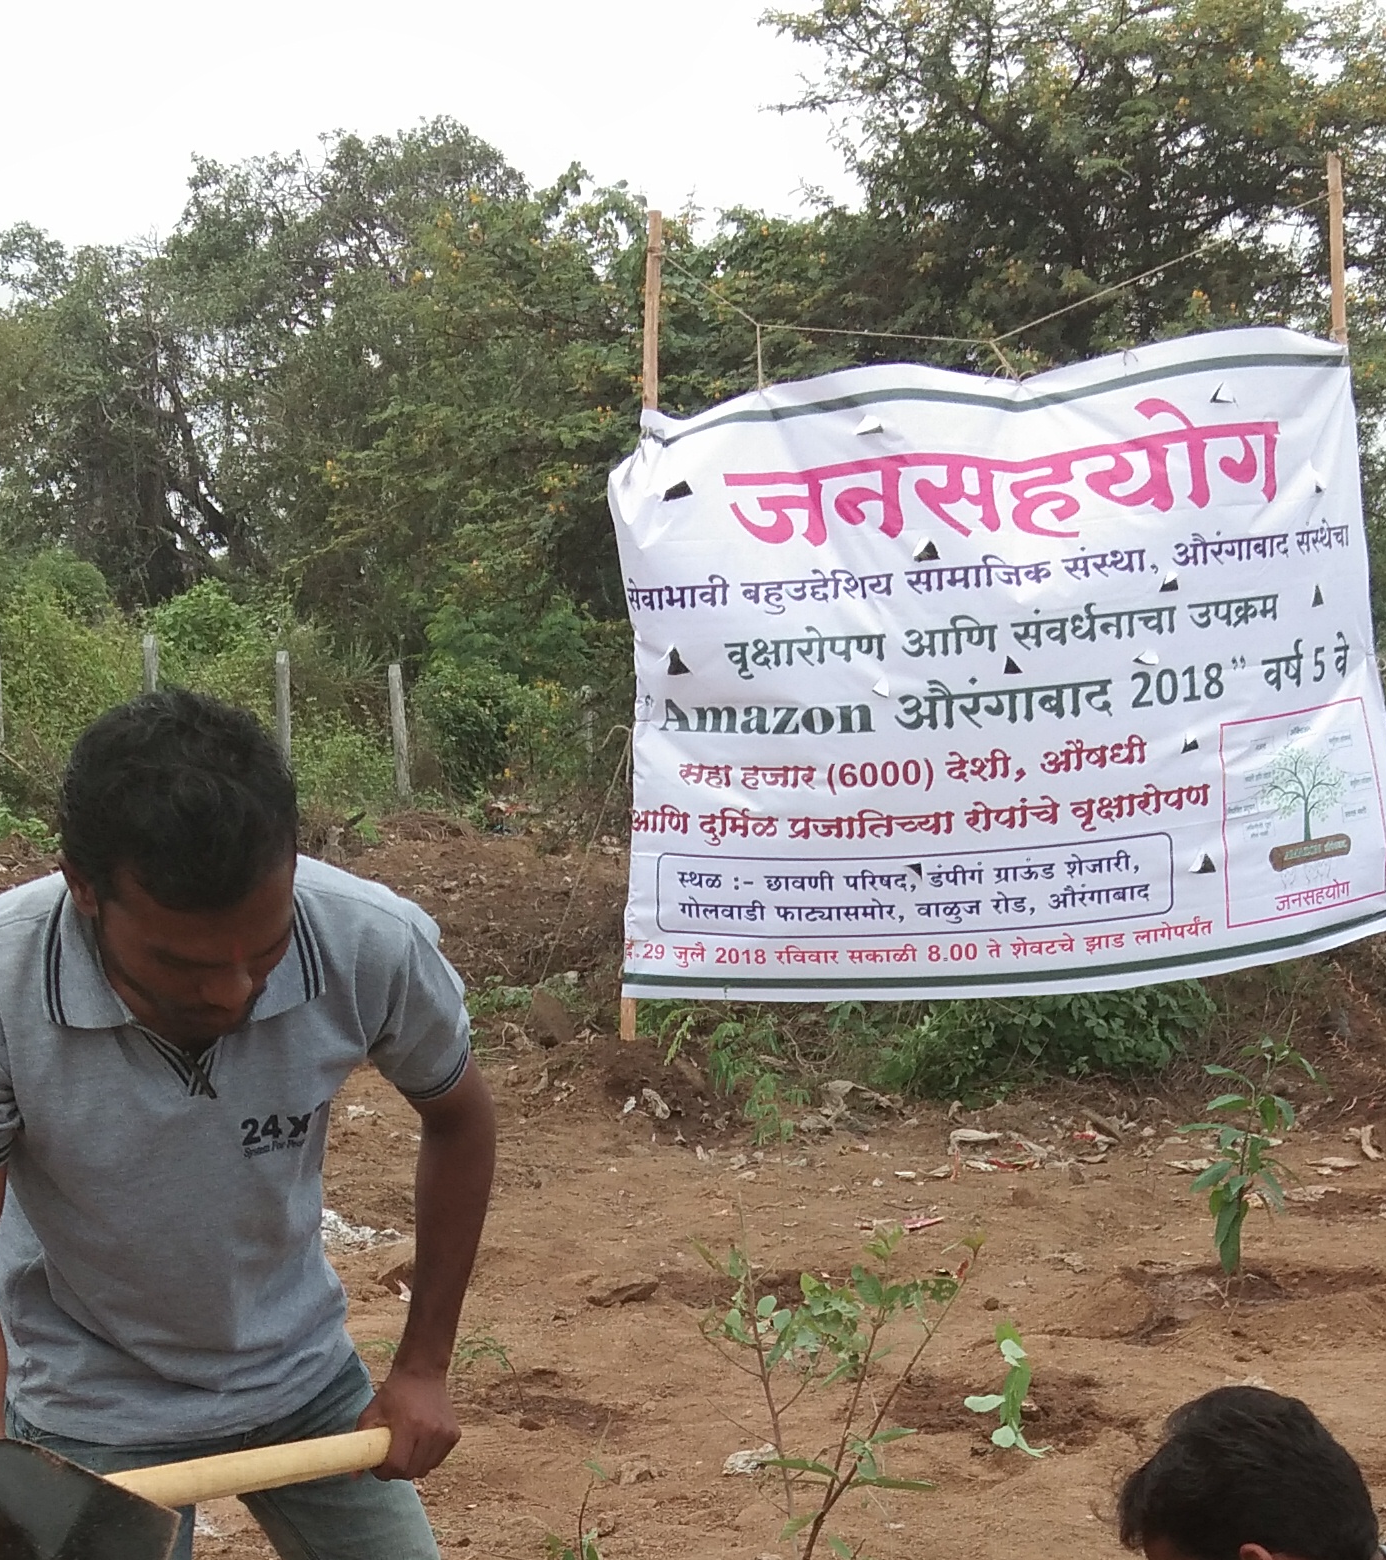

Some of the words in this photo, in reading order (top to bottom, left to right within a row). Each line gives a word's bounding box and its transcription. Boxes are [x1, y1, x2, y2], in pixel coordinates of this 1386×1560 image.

[724, 398, 1280, 547] जनसहयोग
[627, 575, 730, 612] सेवाभावी
[741, 569, 894, 615] बहुउद्देशिय
[905, 555, 1052, 594] सामाजिक
[1173, 531, 1291, 567] औरंगाबाद
[1295, 518, 1350, 554] संस्थेचा
[725, 626, 886, 680] वृक्षारोपण
[902, 614, 997, 658] आणि
[1011, 603, 1177, 652] संवर्धनाचा
[1188, 593, 1279, 629] उपक्रम
[895, 677, 1113, 730] औरंगाबाद
[1261, 638, 1304, 692] वर्ष
[1313, 646, 1325, 683] 5
[1334, 631, 1351, 678] वे
[678, 762, 733, 788] सहा
[741, 765, 816, 790] हजार
[826, 757, 934, 796] (6000)
[1040, 734, 1147, 775] औषधी
[631, 804, 690, 836] आणि
[699, 807, 779, 847] दुर्मिळ
[787, 808, 955, 840] प्रजातिच्या
[965, 795, 1060, 833] रोपांचे
[1070, 783, 1211, 832] वृक्षारोपण
[677, 870, 723, 890] स्थळ
[764, 870, 834, 892] छावणी
[678, 895, 765, 922] गोलवाडी
[915, 899, 982, 924] वाळुज
[1048, 882, 1150, 911] औरंगाबाद
[1275, 878, 1351, 911] जनसहयोग
[672, 941, 707, 968] जुलै
[715, 946, 766, 965] 2018
[774, 944, 839, 966] रविवार
[848, 943, 918, 965] सकाळी
[928, 942, 978, 963] 8.00
[986, 938, 1003, 959] ते
[1010, 932, 1075, 960] शेवटचे
[1083, 929, 1126, 955] झाड
